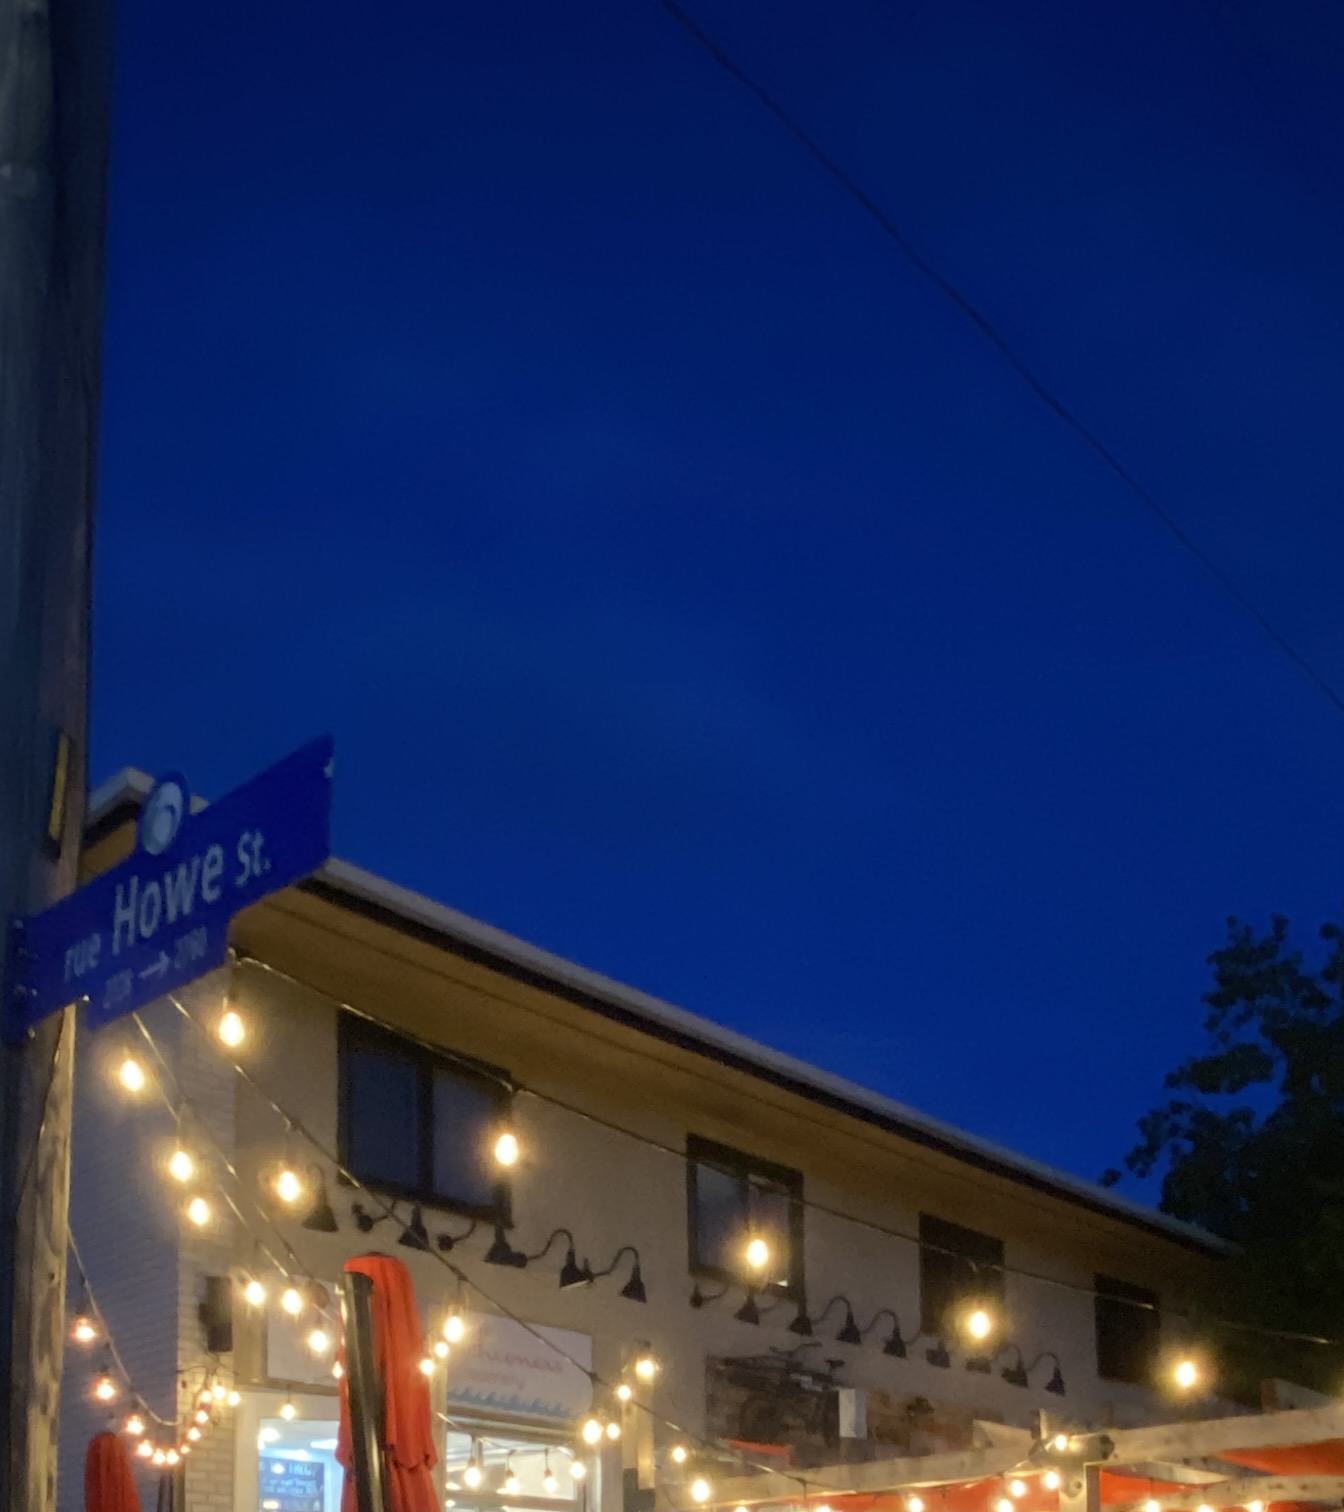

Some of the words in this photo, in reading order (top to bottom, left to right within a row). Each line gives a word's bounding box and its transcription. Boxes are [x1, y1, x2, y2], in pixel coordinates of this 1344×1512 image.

[64, 932, 102, 983] rue
[112, 843, 225, 957] Howe
[234, 827, 272, 889] St.
